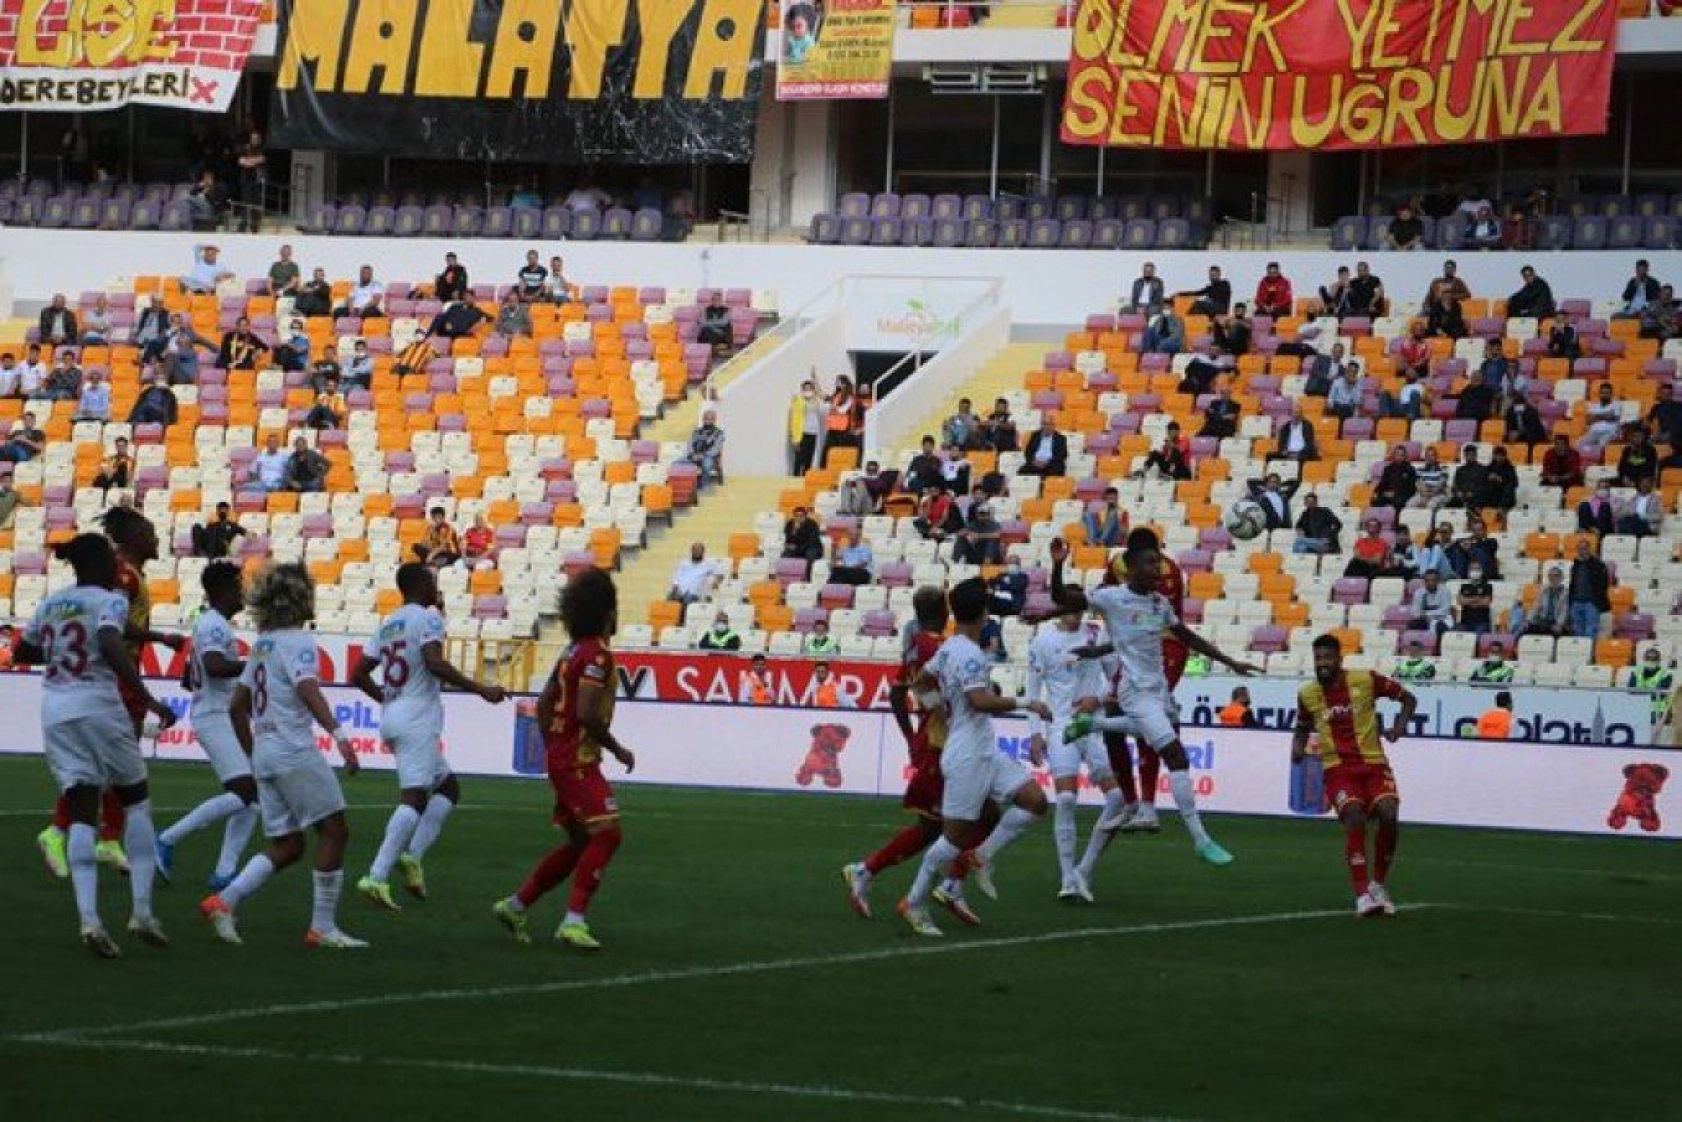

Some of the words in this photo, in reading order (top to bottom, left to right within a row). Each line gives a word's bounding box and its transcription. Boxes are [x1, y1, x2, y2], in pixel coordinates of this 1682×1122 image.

[276, 0, 764, 99] MALATYA
[1290, 60, 1564, 148] UĞRUNA
[254, 663, 267, 717] 8
